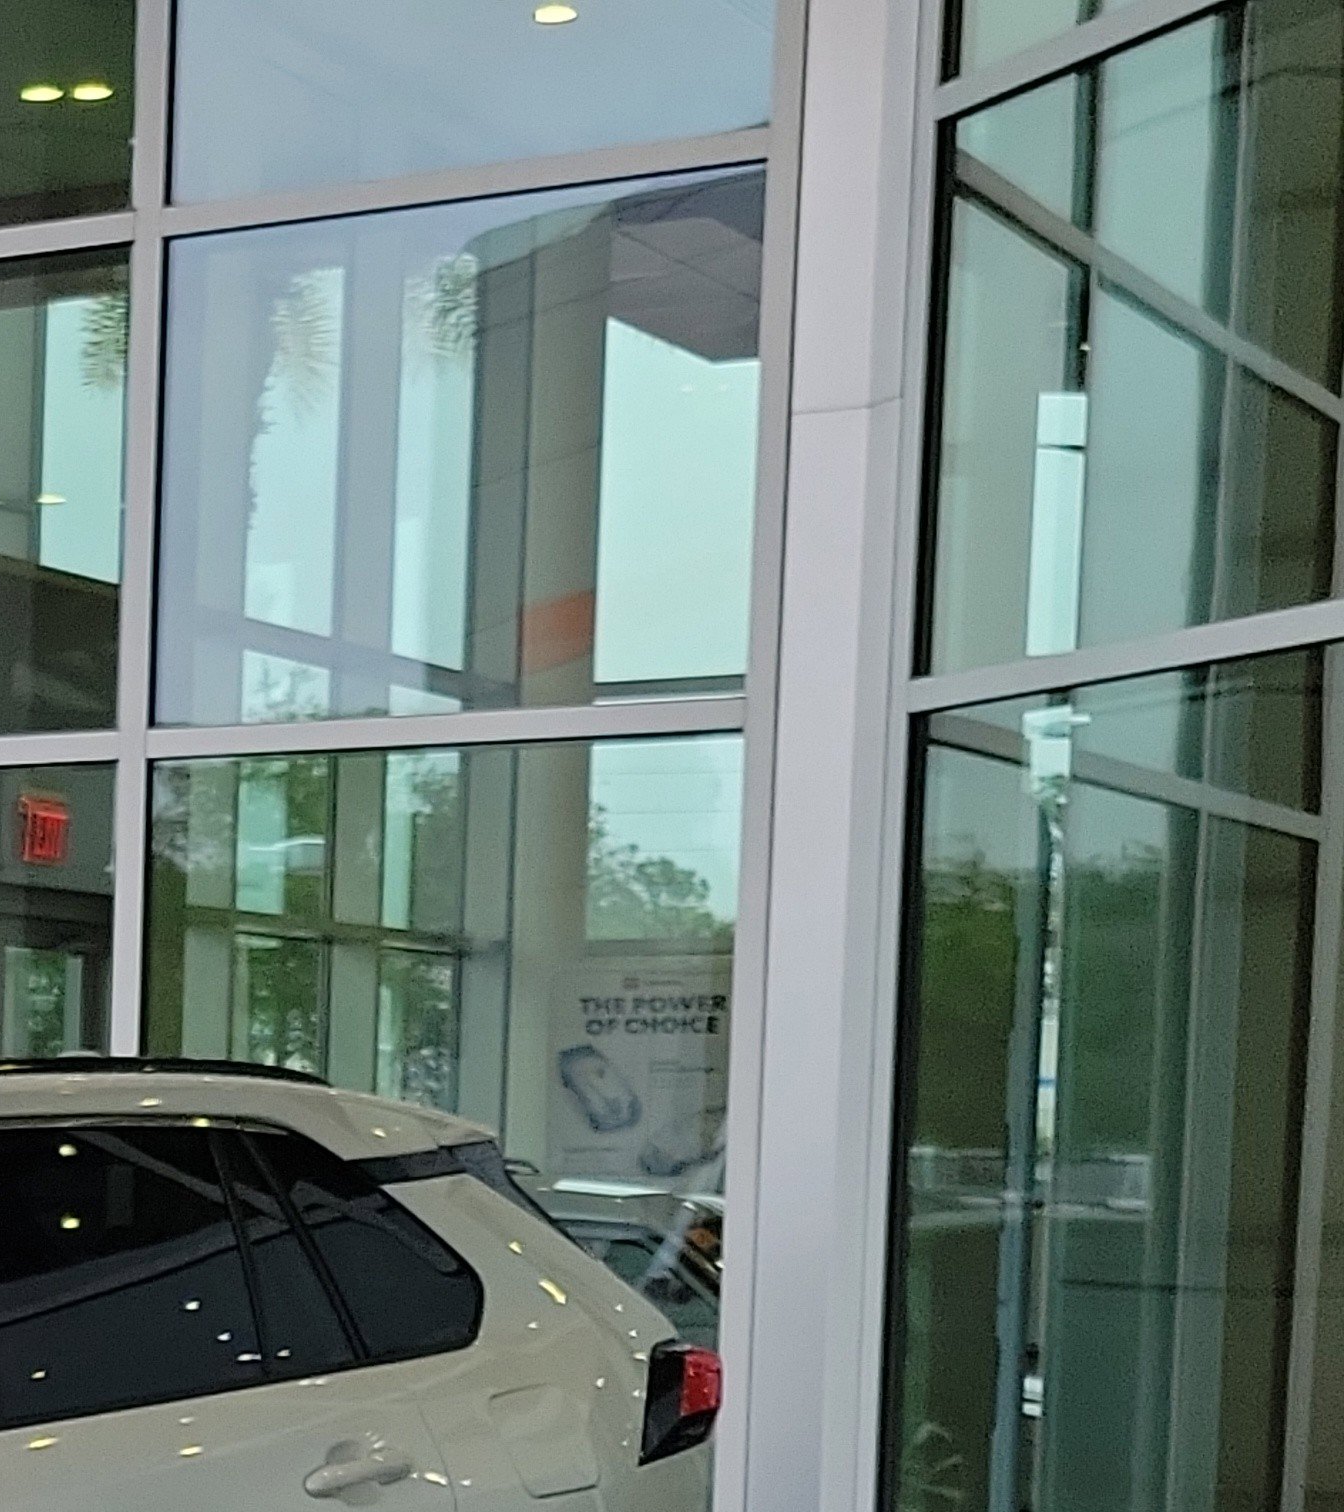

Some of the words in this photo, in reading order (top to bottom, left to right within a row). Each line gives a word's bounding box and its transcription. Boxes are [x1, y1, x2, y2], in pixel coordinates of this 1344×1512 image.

[579, 997, 624, 1014] THE
[632, 995, 727, 1013] POWER
[585, 1017, 618, 1035] OF
[624, 1015, 720, 1035] CHOICE
